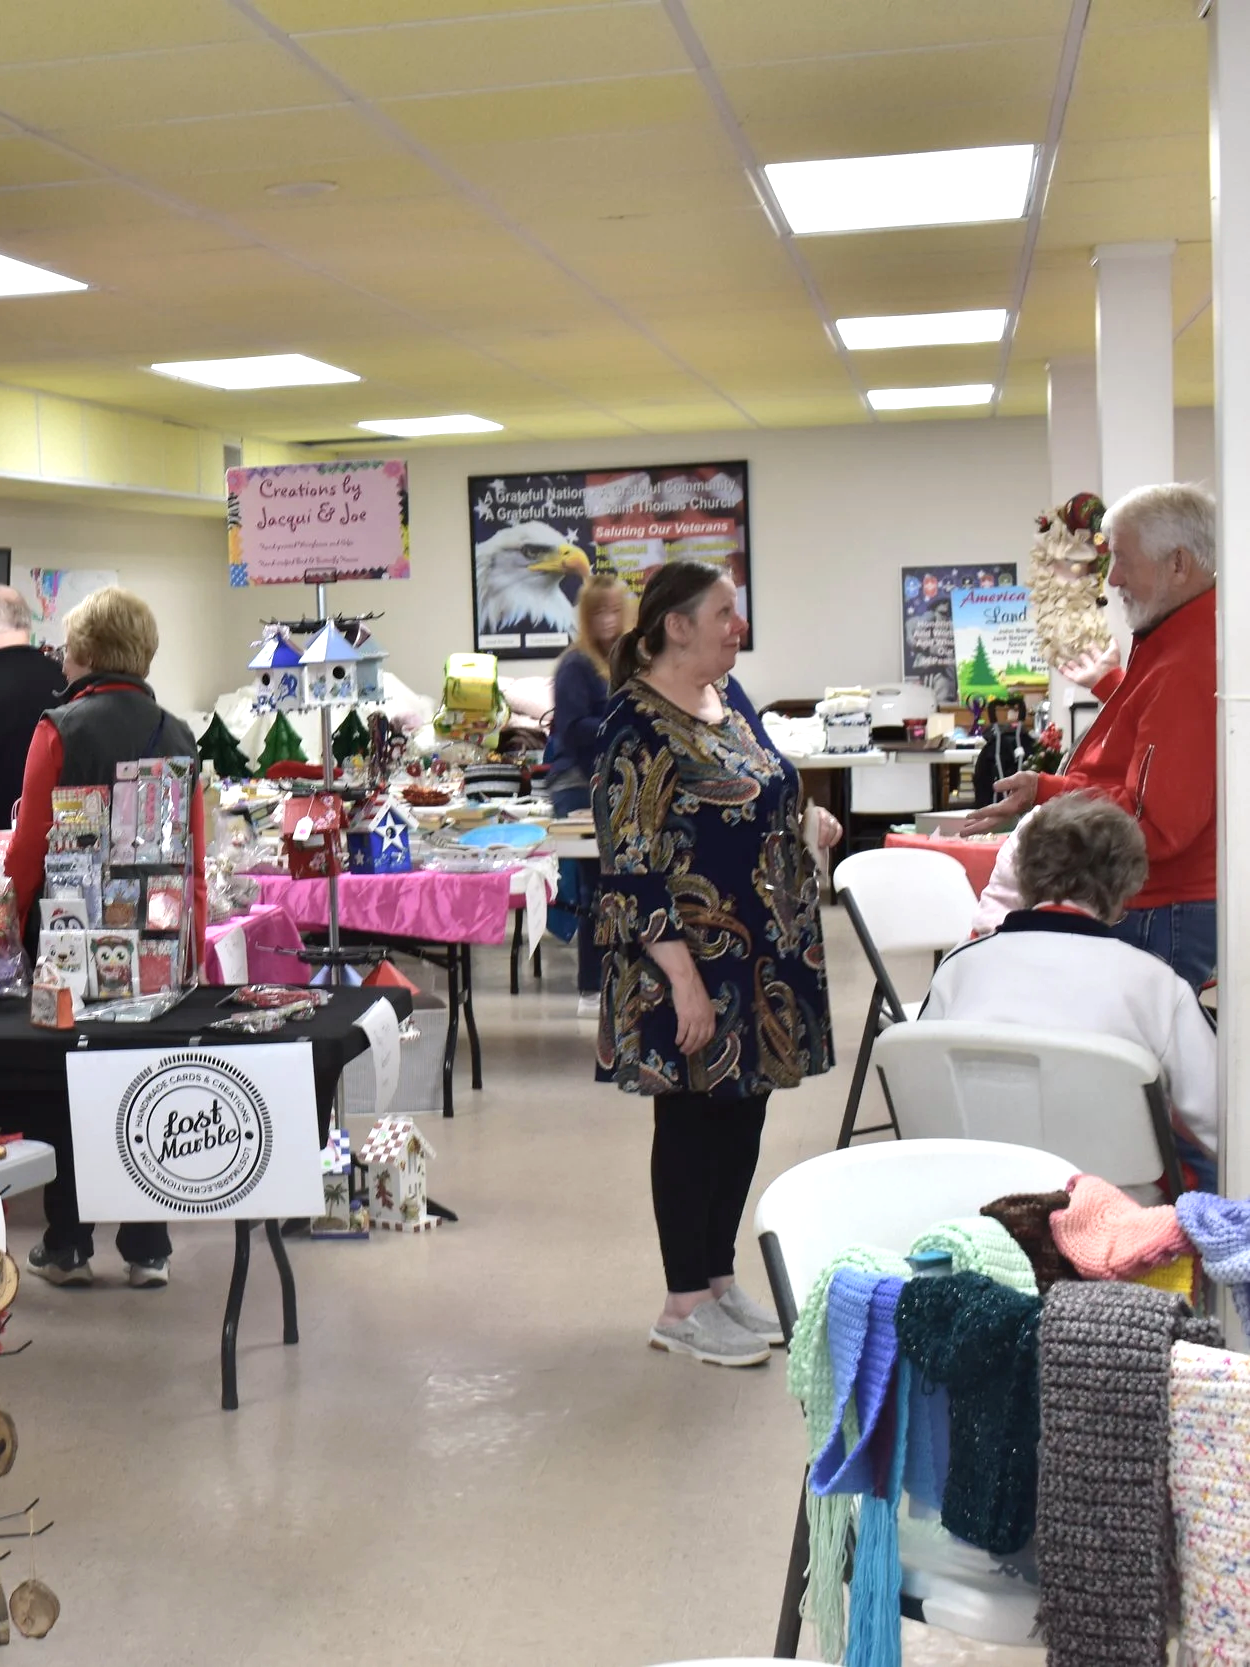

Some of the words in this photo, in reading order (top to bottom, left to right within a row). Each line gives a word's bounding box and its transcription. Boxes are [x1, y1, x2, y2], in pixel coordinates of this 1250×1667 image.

[259, 478, 337, 499] Creations
[342, 475, 363, 501] by
[484, 490, 494, 504] A
[496, 488, 544, 505] Grateful
[546, 486, 586, 500] Nation
[664, 478, 736, 496] Community
[257, 506, 312, 533] Jacqui
[317, 502, 336, 522] &
[340, 502, 367, 525] Joe
[485, 507, 494, 522] A
[496, 504, 545, 521] Grateful
[547, 503, 591, 519] Church
[638, 498, 687, 513] Thomas
[690, 496, 736, 510] Church
[595, 525, 646, 538] Saluting
[648, 524, 672, 535] Our
[675, 521, 729, 534] Veterans
[136, 1080, 168, 1127] HANDMADE
[169, 1072, 202, 1085] CARDS
[203, 1074, 210, 1083] &
[212, 1078, 251, 1124] CREATIONS
[163, 1098, 223, 1139] Lost
[157, 1123, 240, 1165] Marble
